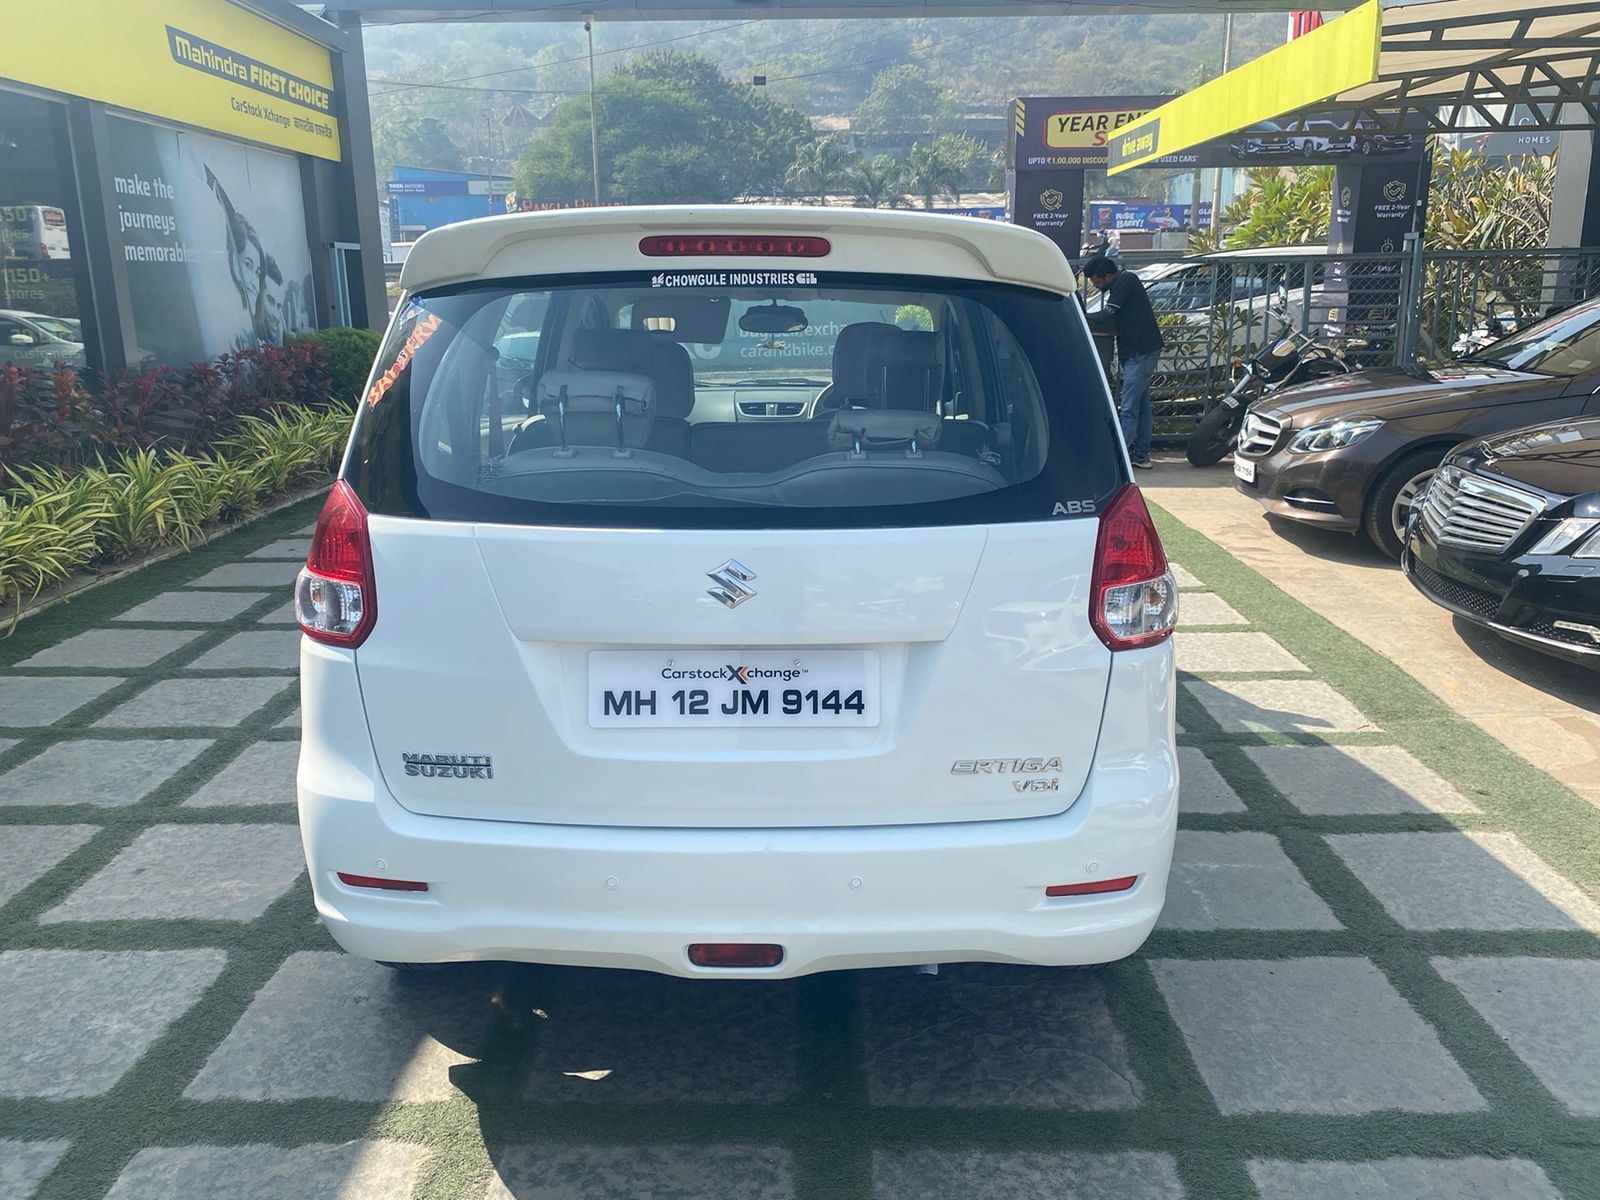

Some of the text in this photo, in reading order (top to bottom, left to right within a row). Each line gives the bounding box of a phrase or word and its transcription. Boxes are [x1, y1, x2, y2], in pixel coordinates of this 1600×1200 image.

[175, 35, 329, 110] Mahindra FIRST CHOICE
[262, 107, 291, 129] Xchange
[1058, 111, 1150, 132] YEAR EN
[1122, 132, 1153, 157] drive away
[1518, 136, 1551, 144] HOMES
[1028, 157, 1046, 165] UPTO
[114, 173, 175, 199] make the
[118, 204, 176, 235] journeys
[666, 274, 727, 287] CHOWGULE
[729, 272, 795, 285] INDUSTRIES
[1052, 499, 1096, 515] ABS
[603, 689, 865, 716] MH 12 JM 9144
[402, 752, 491, 766] MARUTI
[951, 757, 1063, 775] ERTIGA
[404, 764, 494, 779] SUZUKI
